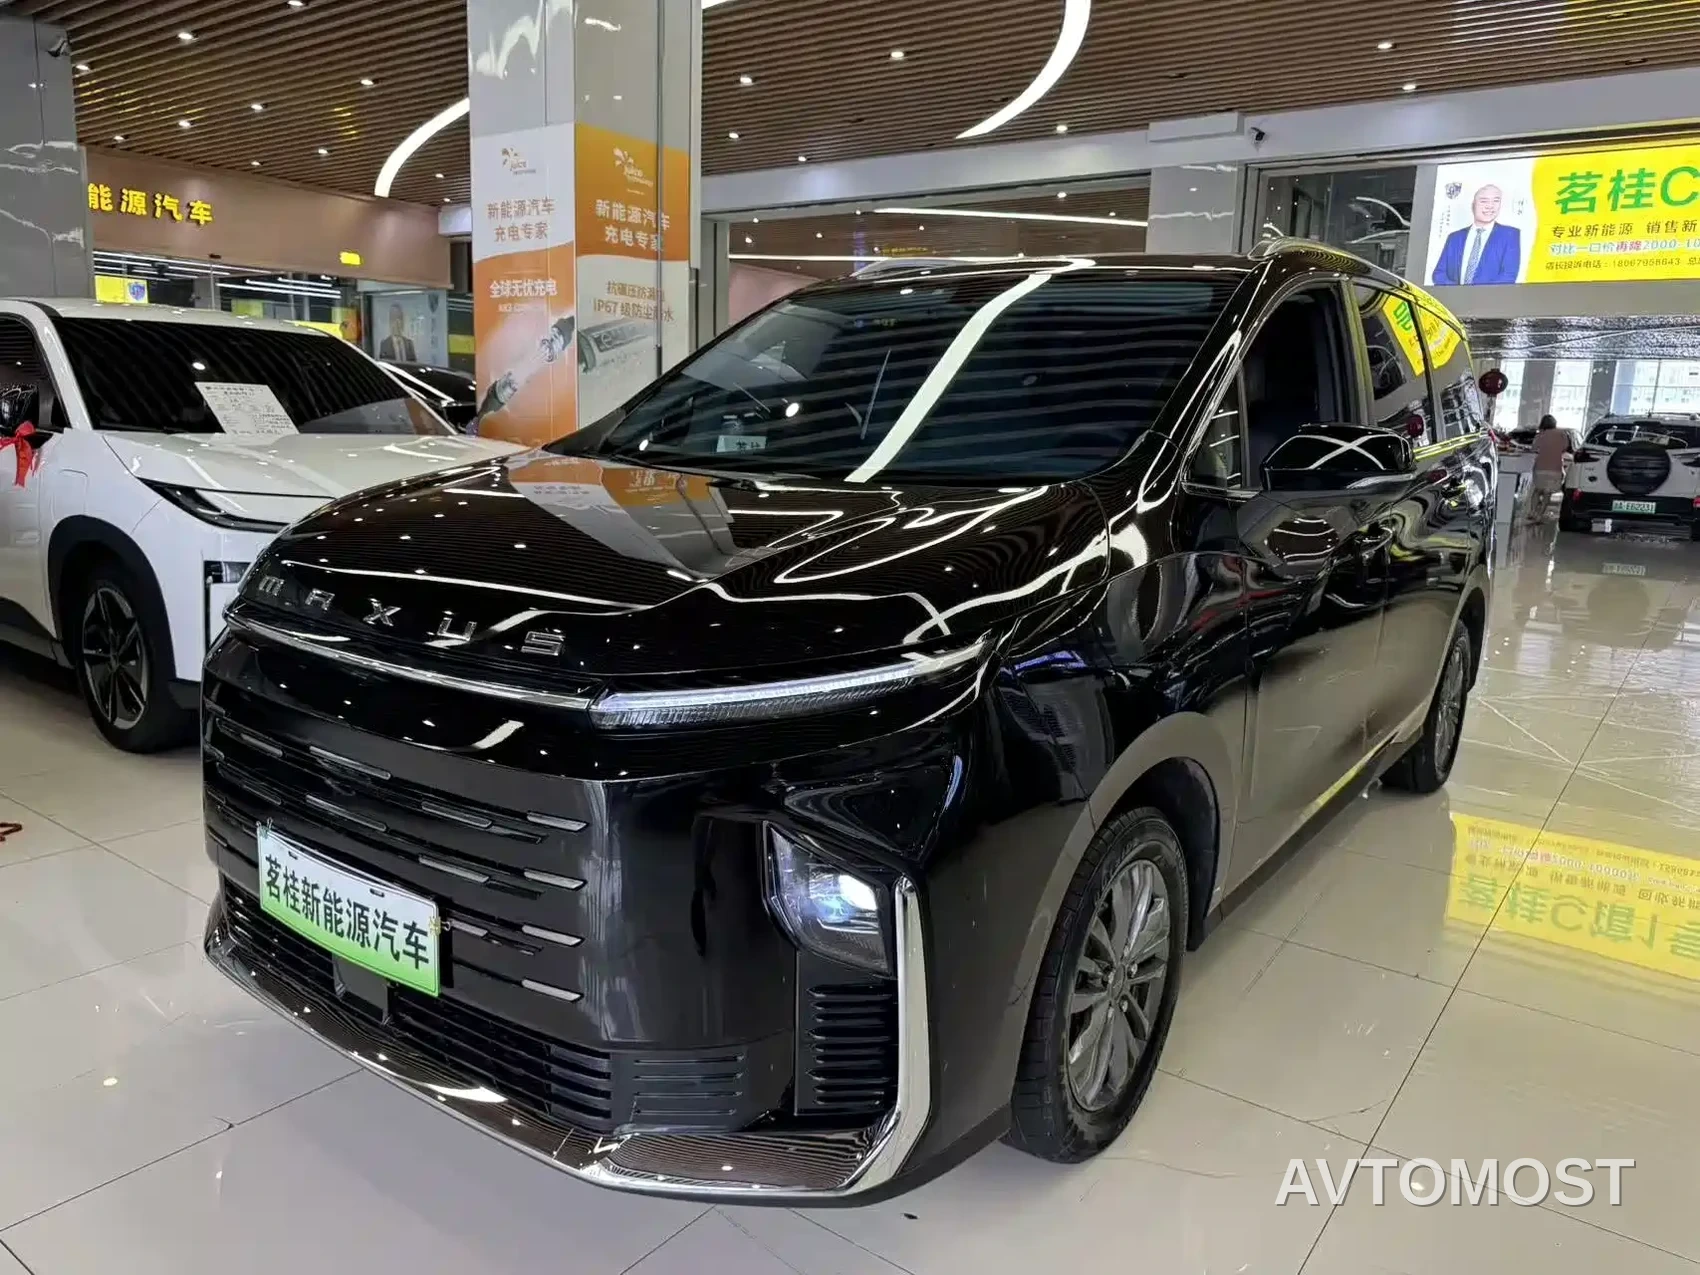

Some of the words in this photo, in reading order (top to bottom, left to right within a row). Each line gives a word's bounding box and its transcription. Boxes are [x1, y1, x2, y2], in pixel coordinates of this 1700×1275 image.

[1554, 166, 1700, 214] 茗桂C
[88, 183, 213, 225] 能源汽车
[487, 197, 554, 219] 新能源汽车
[595, 199, 670, 230] 新能源汽车
[494, 221, 549, 242] 充电专家
[1552, 222, 1634, 239] 专业新能源
[1646, 219, 1698, 234] 销售新
[490, 278, 558, 298] 全球无忧充电
[593, 299, 618, 316] IP67
[265, 854, 431, 970] 茗桂新能源汽车
